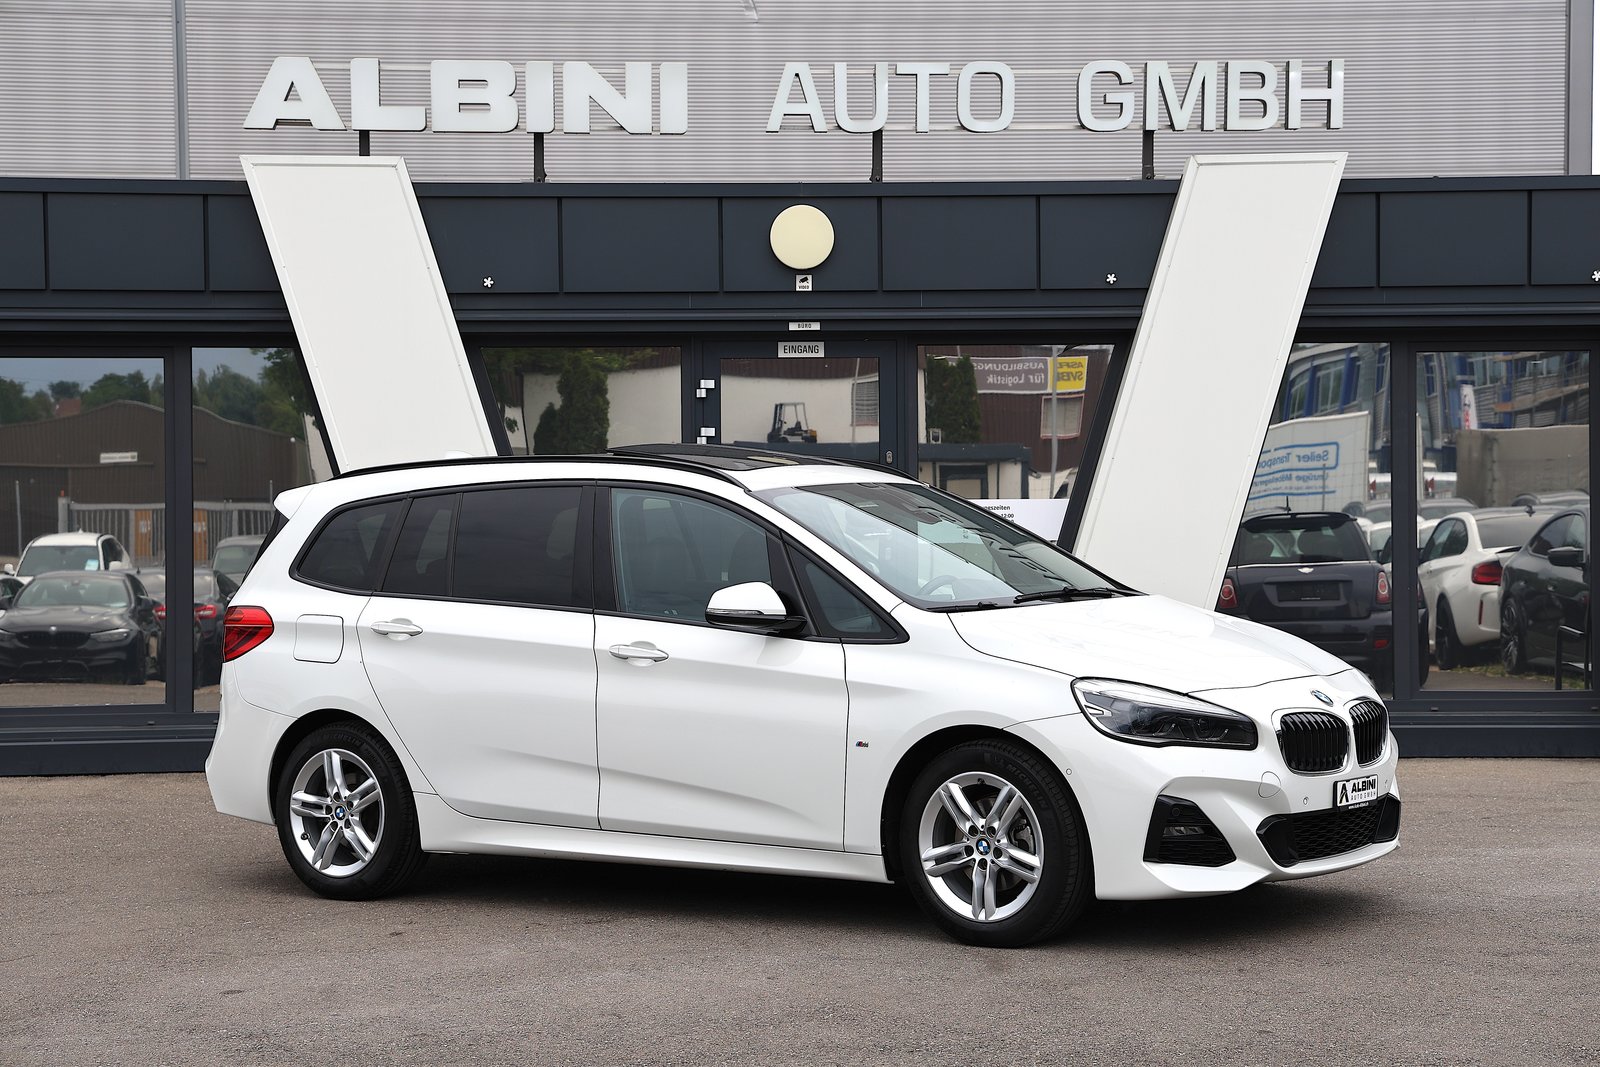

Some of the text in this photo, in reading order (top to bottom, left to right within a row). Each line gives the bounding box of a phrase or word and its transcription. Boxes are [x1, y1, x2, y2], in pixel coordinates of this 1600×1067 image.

[243, 56, 1345, 135] ALBINI AUTO GMBH
[783, 345, 819, 354] EINGANG
[1006, 763, 1049, 809] MICHELIN
[1351, 778, 1376, 793] ALBINI
